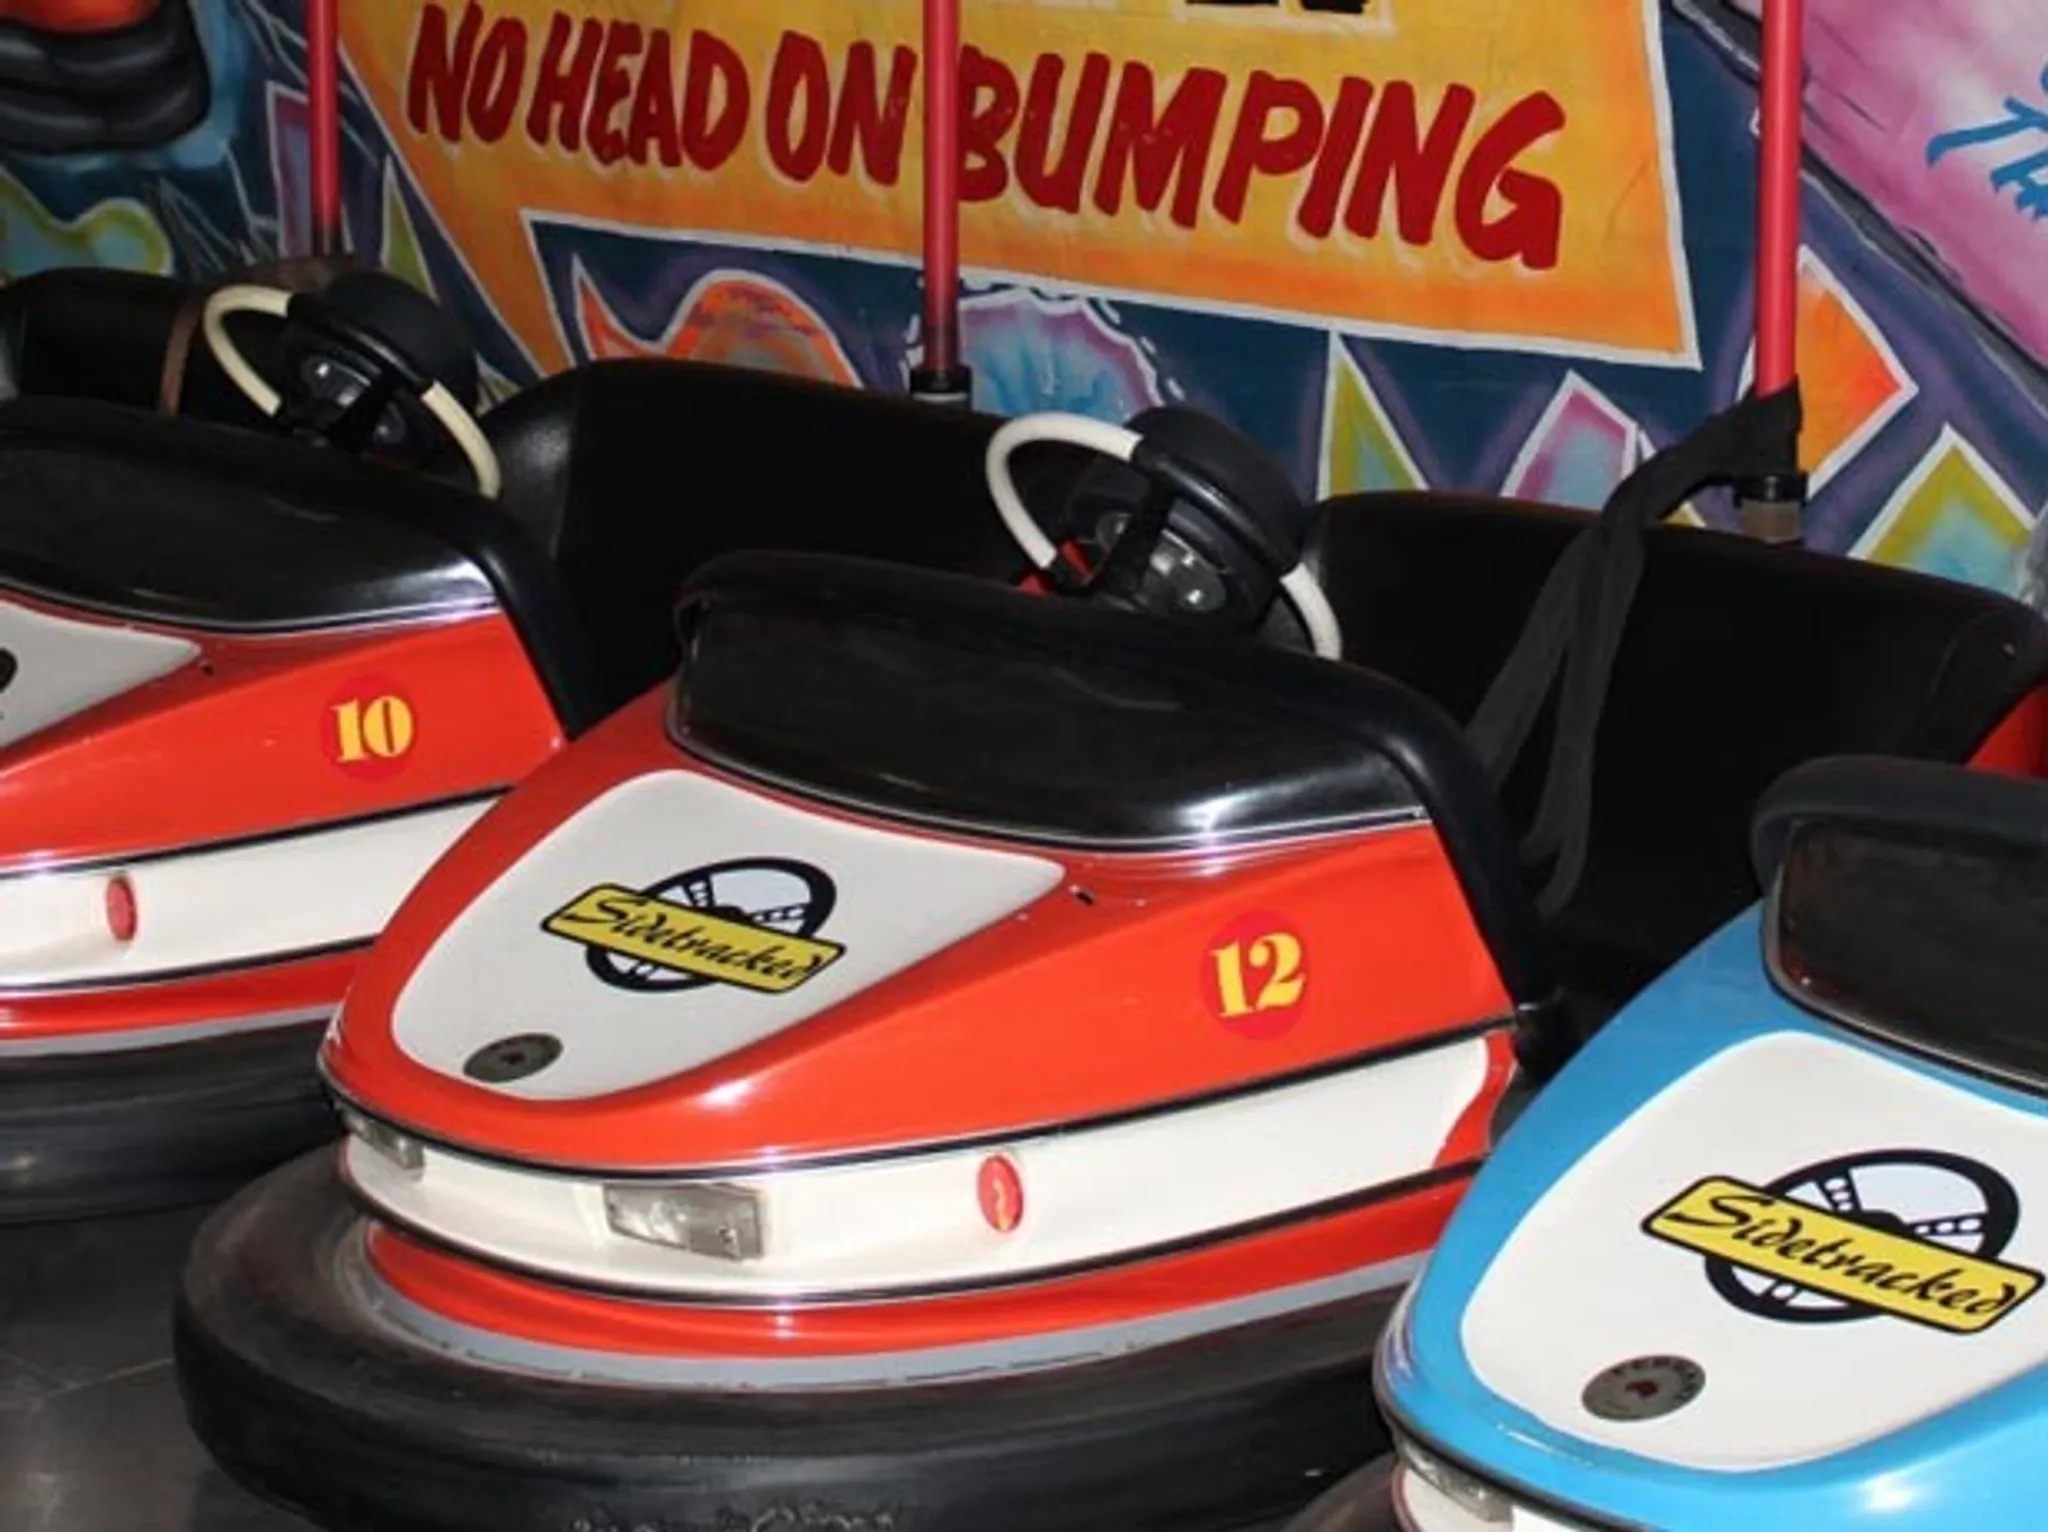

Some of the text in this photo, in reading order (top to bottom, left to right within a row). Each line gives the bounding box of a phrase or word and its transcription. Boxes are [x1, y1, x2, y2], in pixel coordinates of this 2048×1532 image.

[407, 2, 1566, 270] NO HEAD ON BUMPING
[331, 693, 414, 763] 10
[560, 896, 823, 983] Sidetracked
[1211, 931, 1306, 1018] 12
[1661, 1193, 2018, 1316] Sidetracked
